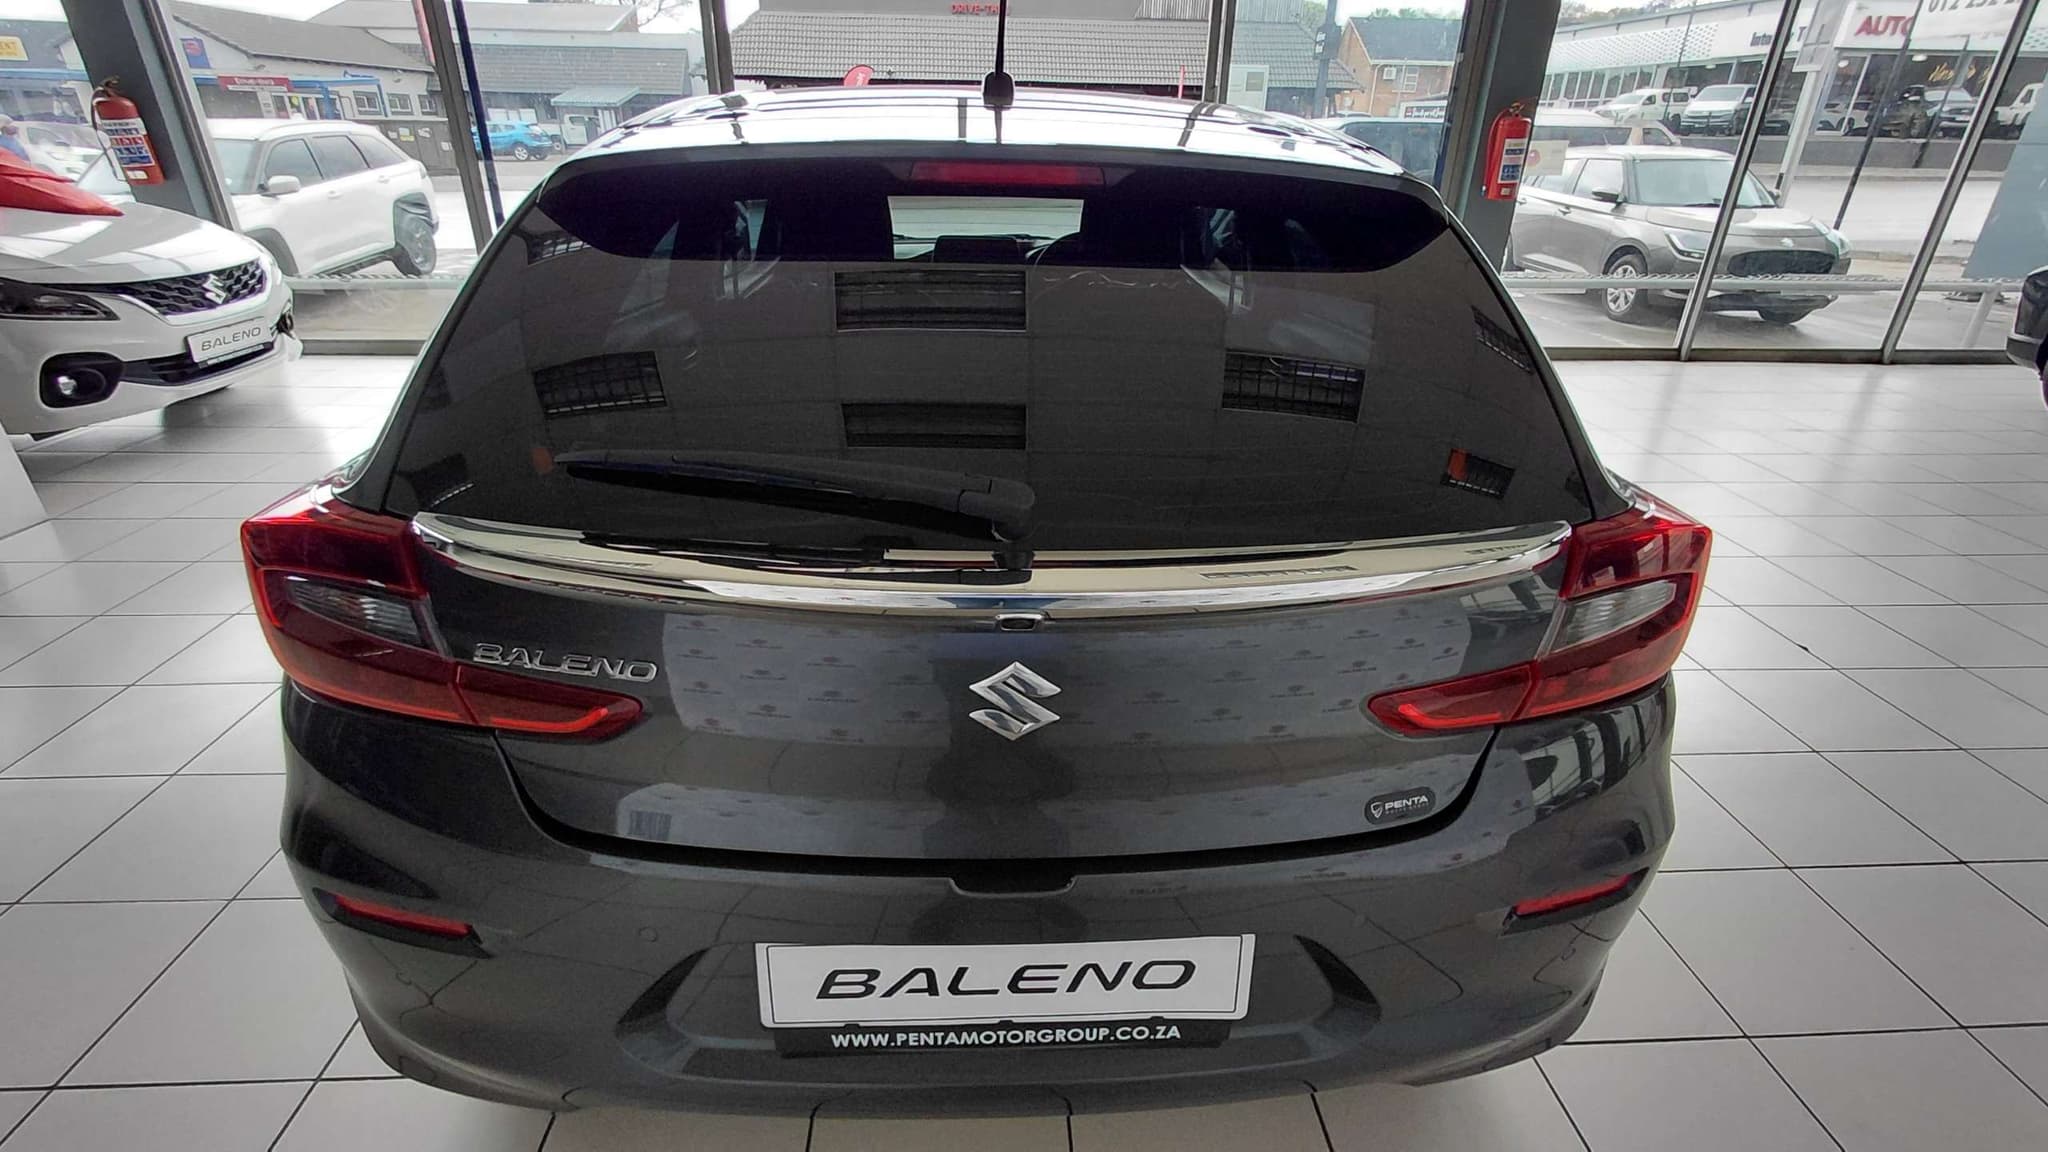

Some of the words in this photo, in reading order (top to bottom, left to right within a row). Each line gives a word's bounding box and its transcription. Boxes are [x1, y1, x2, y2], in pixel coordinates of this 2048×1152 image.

[201, 327, 261, 351] BALENO
[472, 642, 658, 683] BALENO
[1384, 795, 1429, 810] PENTA
[815, 959, 1197, 1000] BALENO
[831, 1025, 1181, 1048] WWW.PENTAMOTORGROUP.CO.ZA
